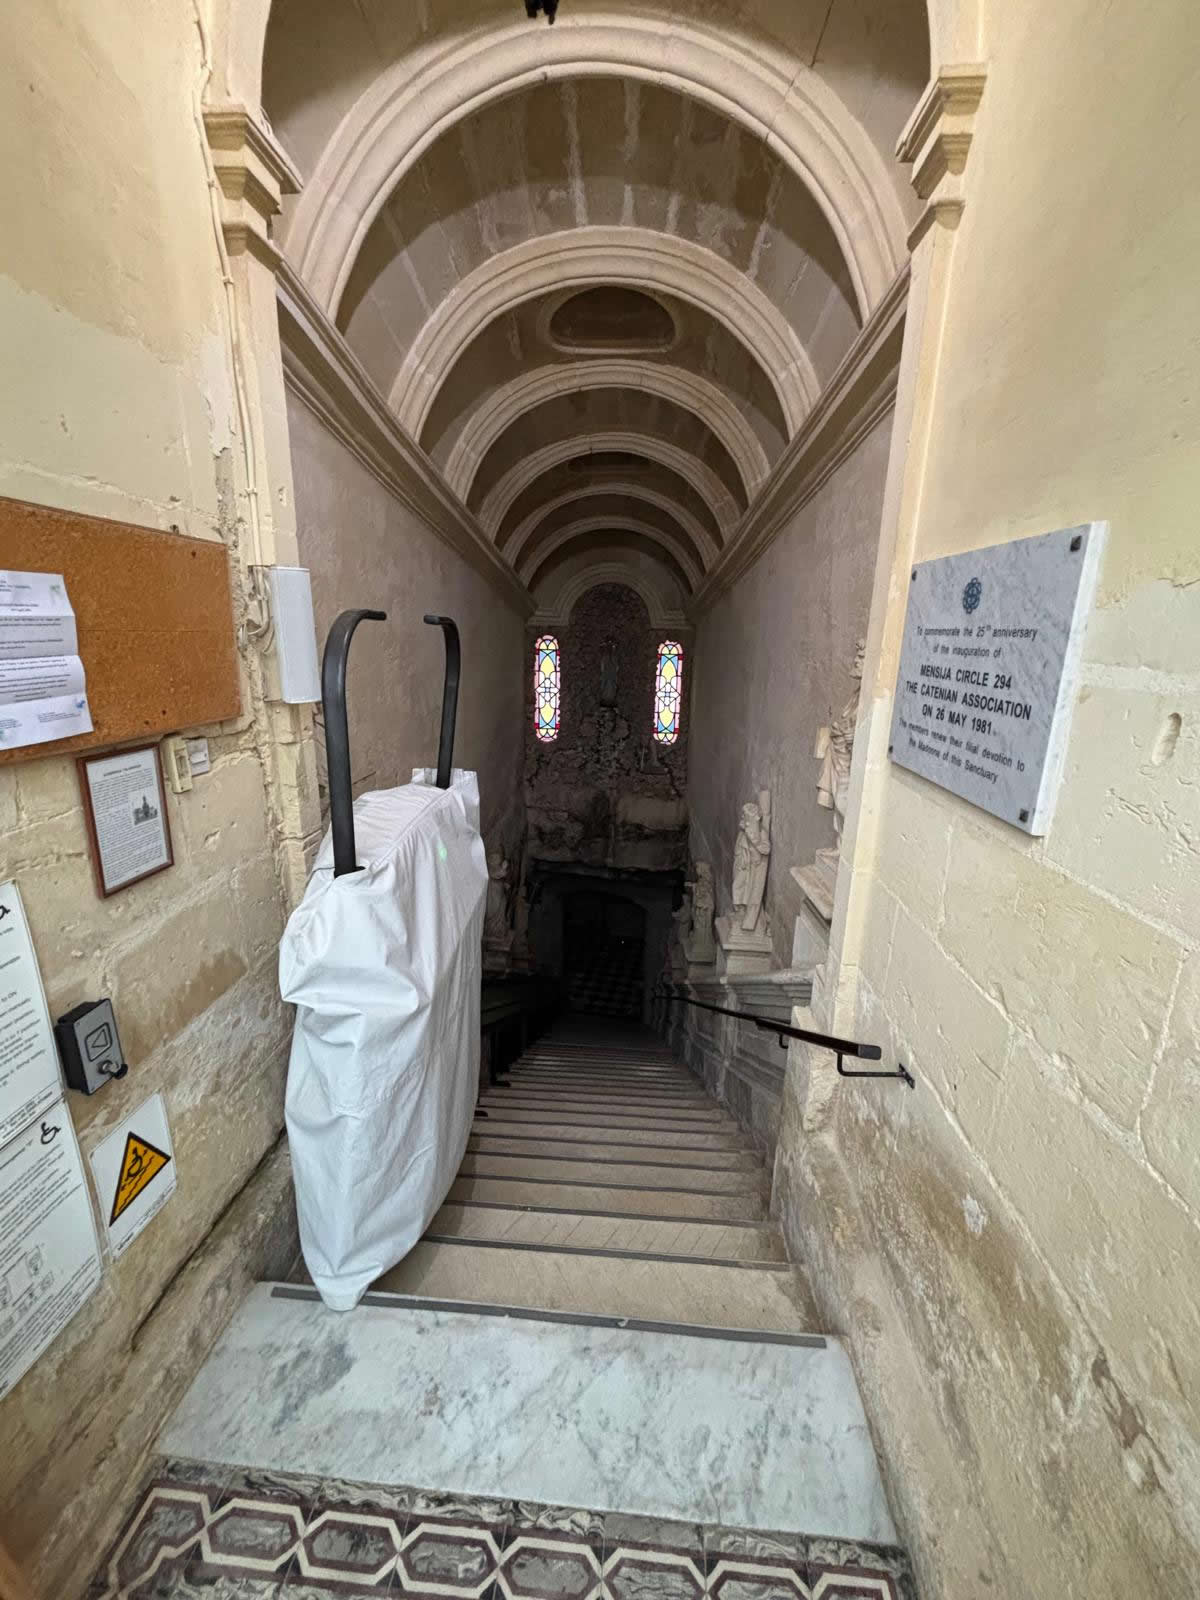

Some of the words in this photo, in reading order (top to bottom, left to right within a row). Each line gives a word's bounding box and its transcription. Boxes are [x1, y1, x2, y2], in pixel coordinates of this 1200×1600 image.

[924, 627, 960, 636] commemorate
[963, 627, 973, 636] the
[992, 627, 1038, 642] anniversary
[933, 644, 939, 653] of
[941, 645, 949, 654] the
[952, 647, 990, 658] inauguration
[993, 647, 1001, 658] of
[920, 664, 951, 680] MENSIJA
[955, 669, 989, 687] CIRCLE
[993, 674, 1012, 690] 294
[906, 680, 918, 694] THE
[920, 684, 958, 703] CATENIAN
[961, 692, 1032, 720] ASSOCIATION
[922, 704, 933, 717] ON
[935, 707, 945, 720] 26
[948, 710, 967, 727] MAY
[899, 717, 907, 728] The
[908, 722, 929, 736] members
[931, 730, 947, 743] renew
[949, 735, 963, 748] their
[965, 740, 979, 755] filial
[982, 747, 1013, 767] devotion
[1016, 760, 1025, 772] to
[908, 737, 916, 748] the
[918, 740, 940, 758] Madonna
[943, 752, 949, 761] of
[951, 754, 962, 767] this
[965, 759, 998, 784] Sanctuary
